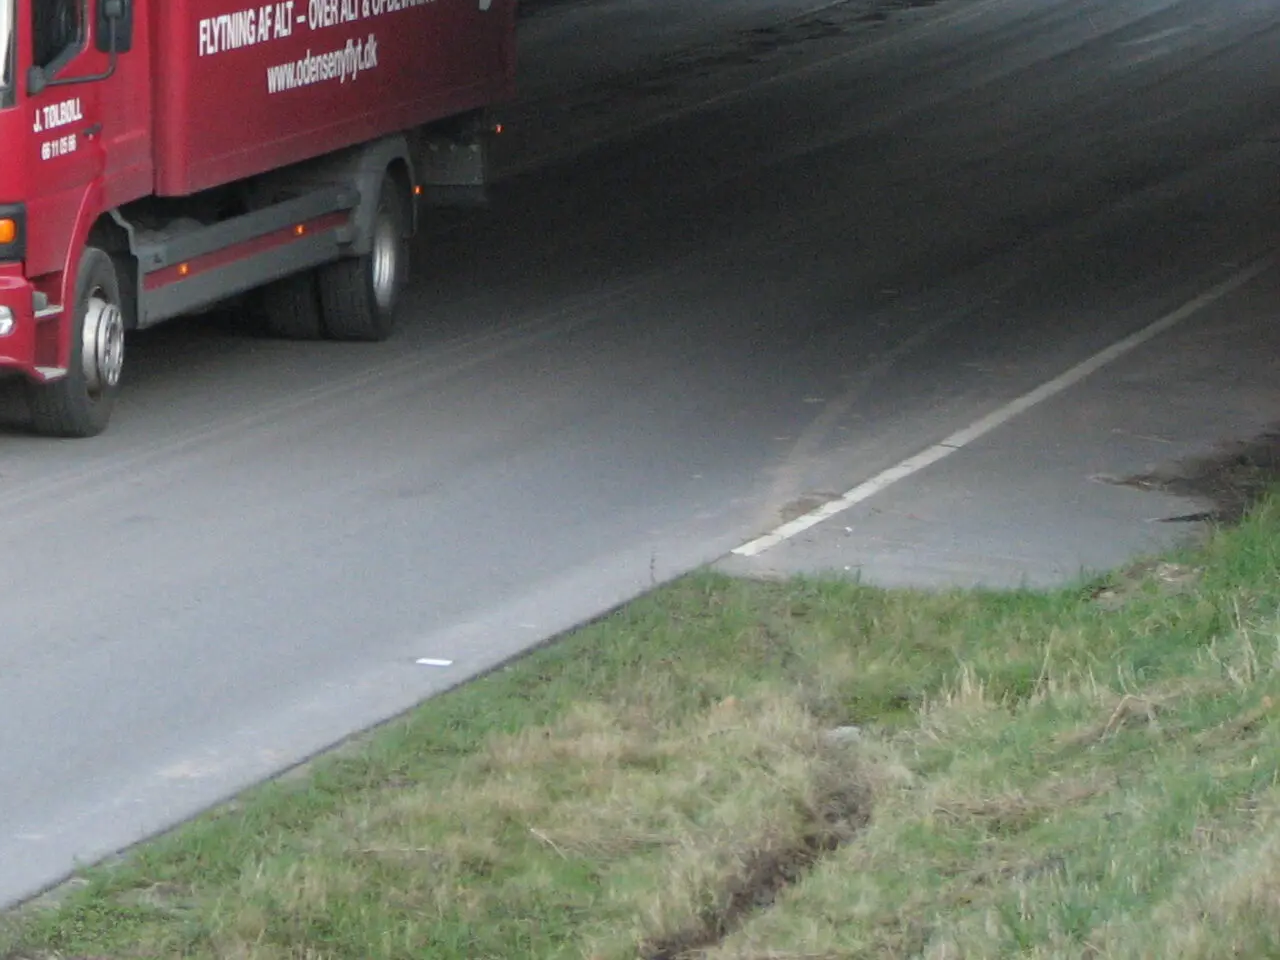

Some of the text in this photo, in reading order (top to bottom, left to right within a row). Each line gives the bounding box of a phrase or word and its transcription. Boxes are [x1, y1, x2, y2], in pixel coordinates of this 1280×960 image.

[199, 7, 257, 56] FLYTNING
[257, 4, 273, 42] AF
[274, 0, 294, 38] ALT
[267, 33, 377, 94] www.odensenyflyt.dk
